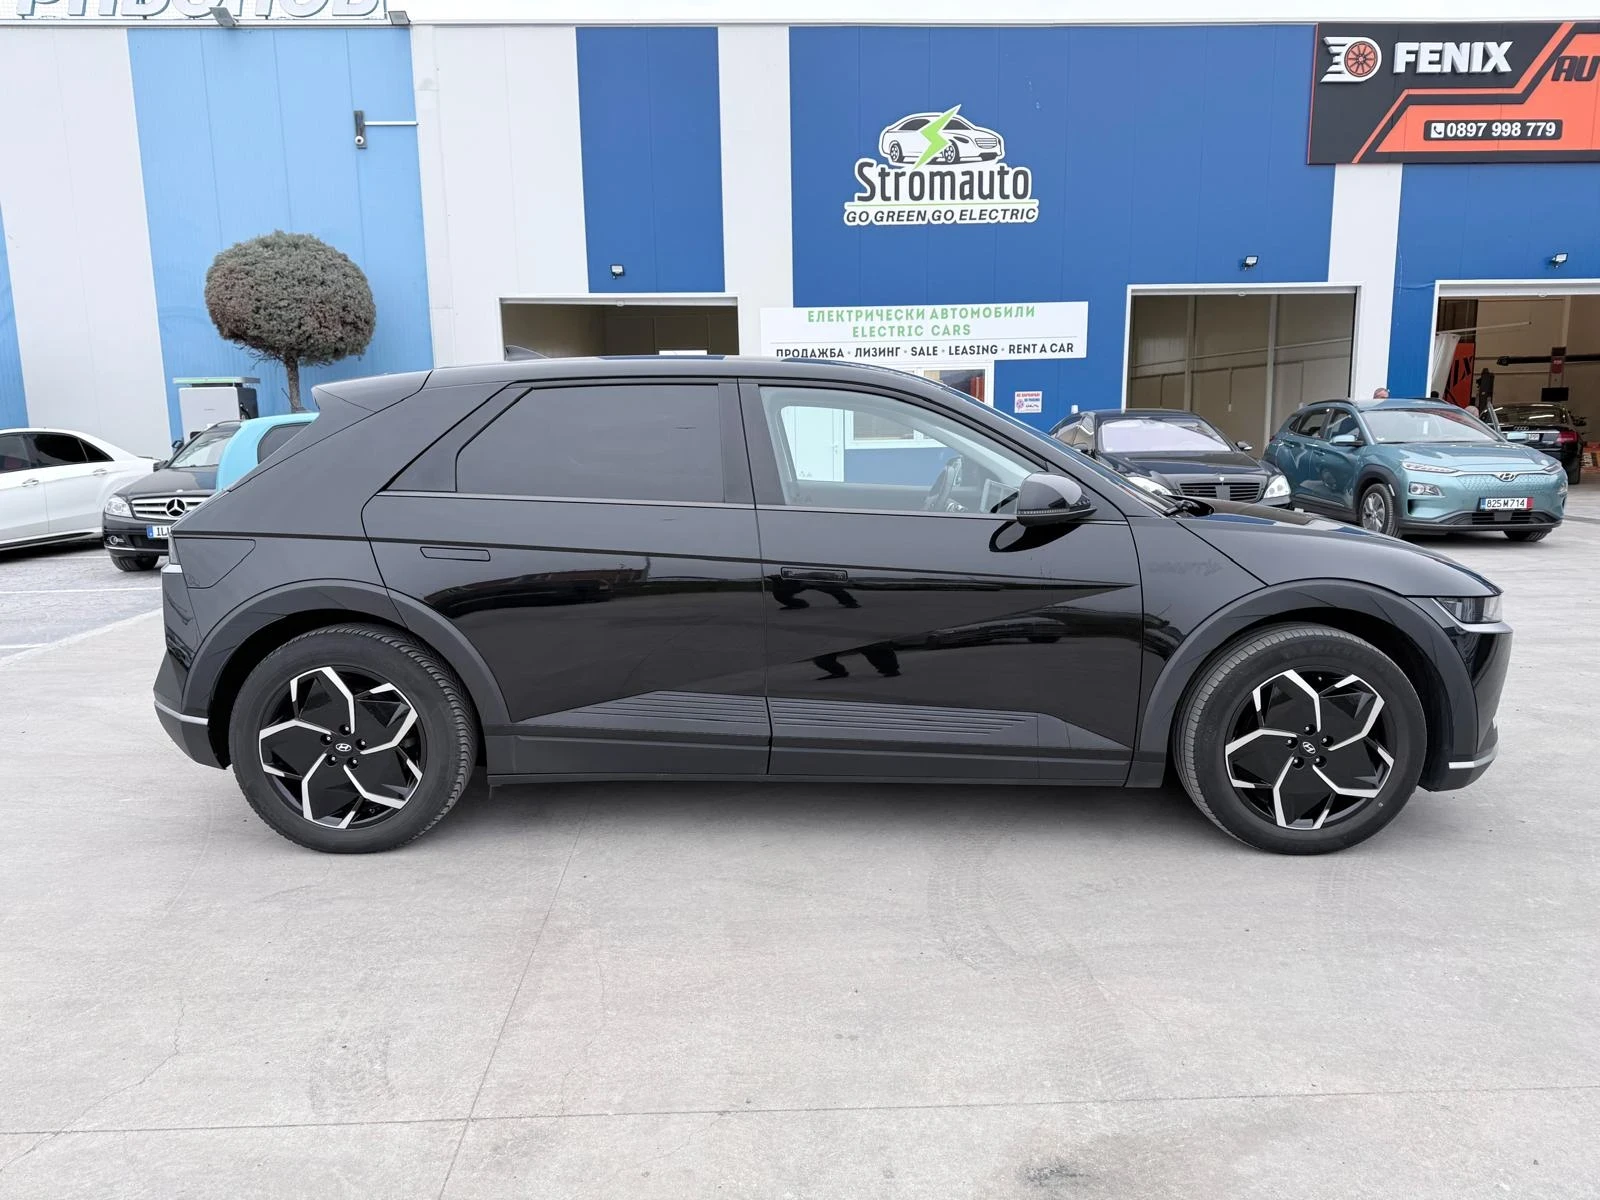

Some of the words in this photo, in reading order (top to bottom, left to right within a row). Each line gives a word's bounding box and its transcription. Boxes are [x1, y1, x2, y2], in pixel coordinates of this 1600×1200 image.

[1393, 41, 1513, 73] FENIX
[1551, 55, 1600, 82] AU
[1446, 122, 1487, 138] 0897
[1491, 122, 1521, 137] 998
[1525, 121, 1556, 137] 779
[857, 161, 1030, 202] Stromauto
[846, 210, 870, 222] GO
[874, 209, 927, 222] GREEN
[931, 209, 955, 221] GO
[958, 208, 1037, 221] ELECTRIC
[807, 308, 926, 323] ЕЛЕКТРИЧЕСКИ
[930, 306, 1036, 320] АВТОМОБИЛИ
[852, 325, 924, 338] ELECTRIC
[931, 324, 971, 336] CARS
[776, 348, 845, 358] ПРОДАЖБА
[854, 346, 901, 358] ЛИЗИНГ
[911, 346, 938, 356] SALE
[948, 344, 998, 355] LEASING
[1008, 343, 1037, 354] RENT
[1039, 343, 1048, 354] A
[1050, 342, 1074, 353] CAR
